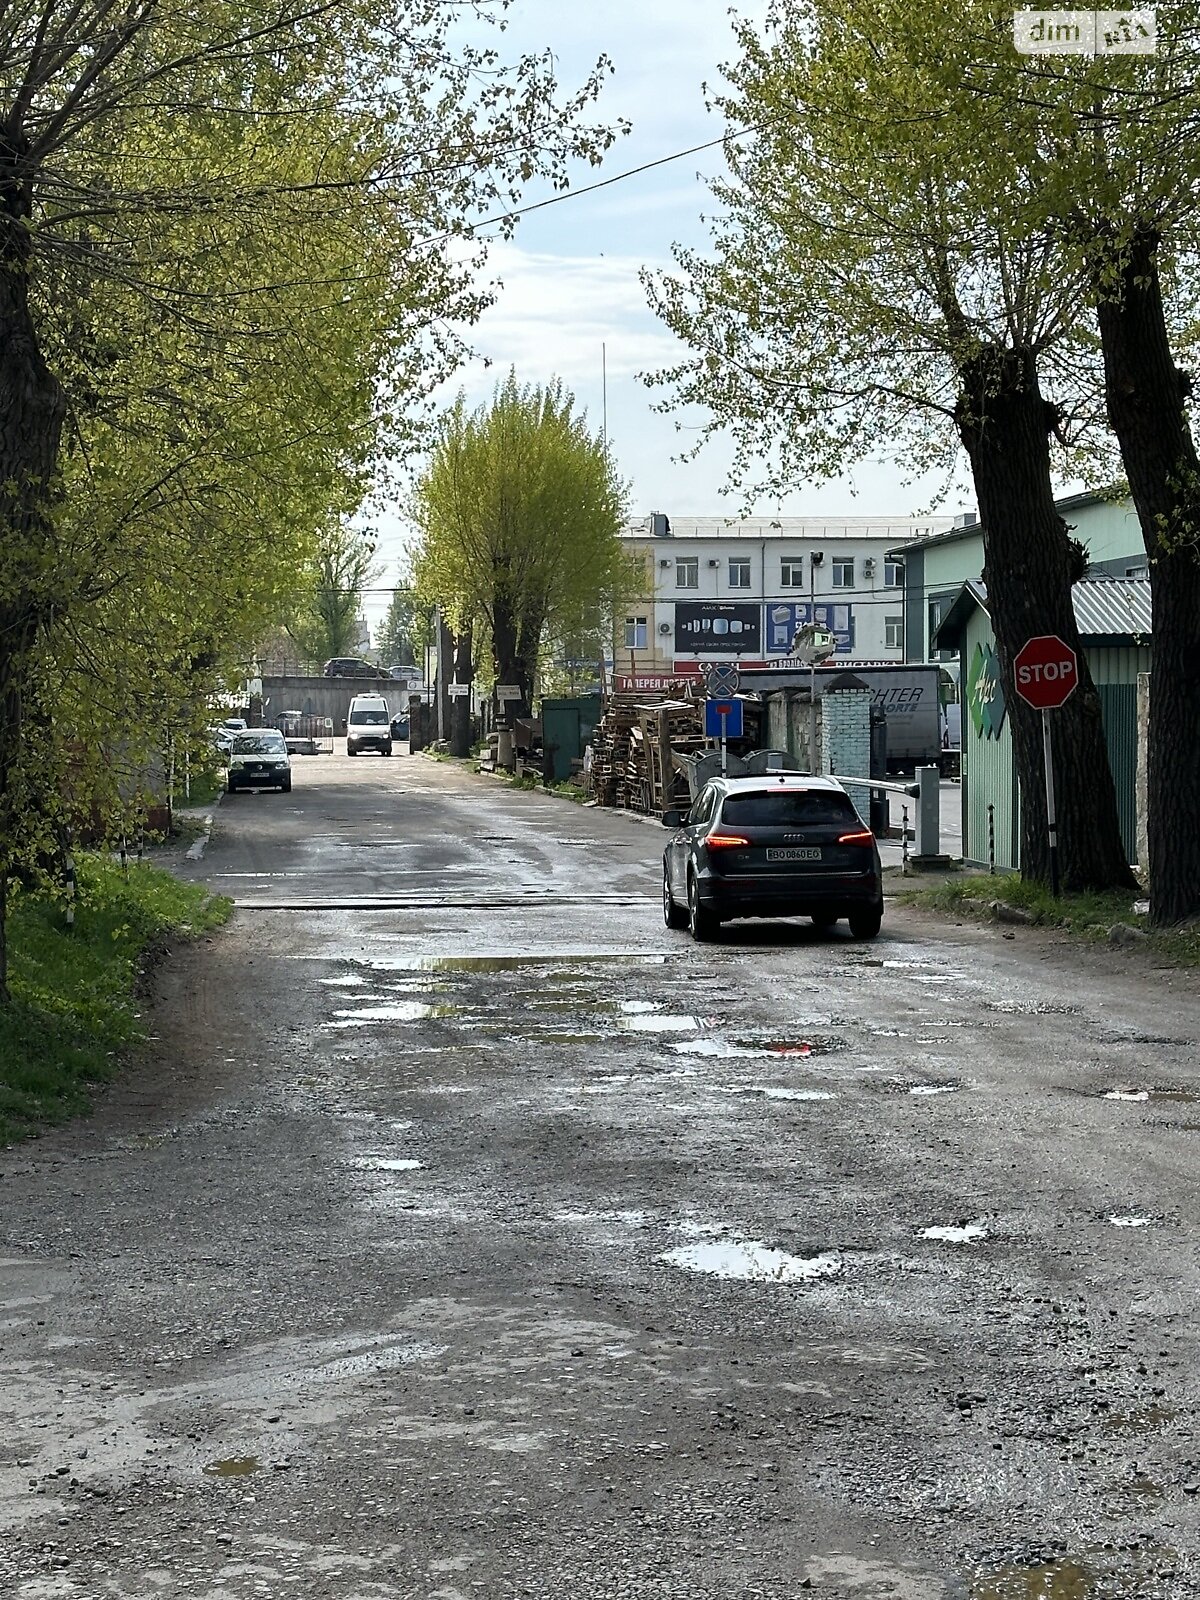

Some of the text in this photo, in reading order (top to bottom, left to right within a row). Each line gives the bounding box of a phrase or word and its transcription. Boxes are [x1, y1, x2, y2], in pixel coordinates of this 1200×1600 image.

[1018, 661, 1073, 684] STOP
[869, 687, 924, 703] CHTER
[885, 703, 918, 713] ORTE
